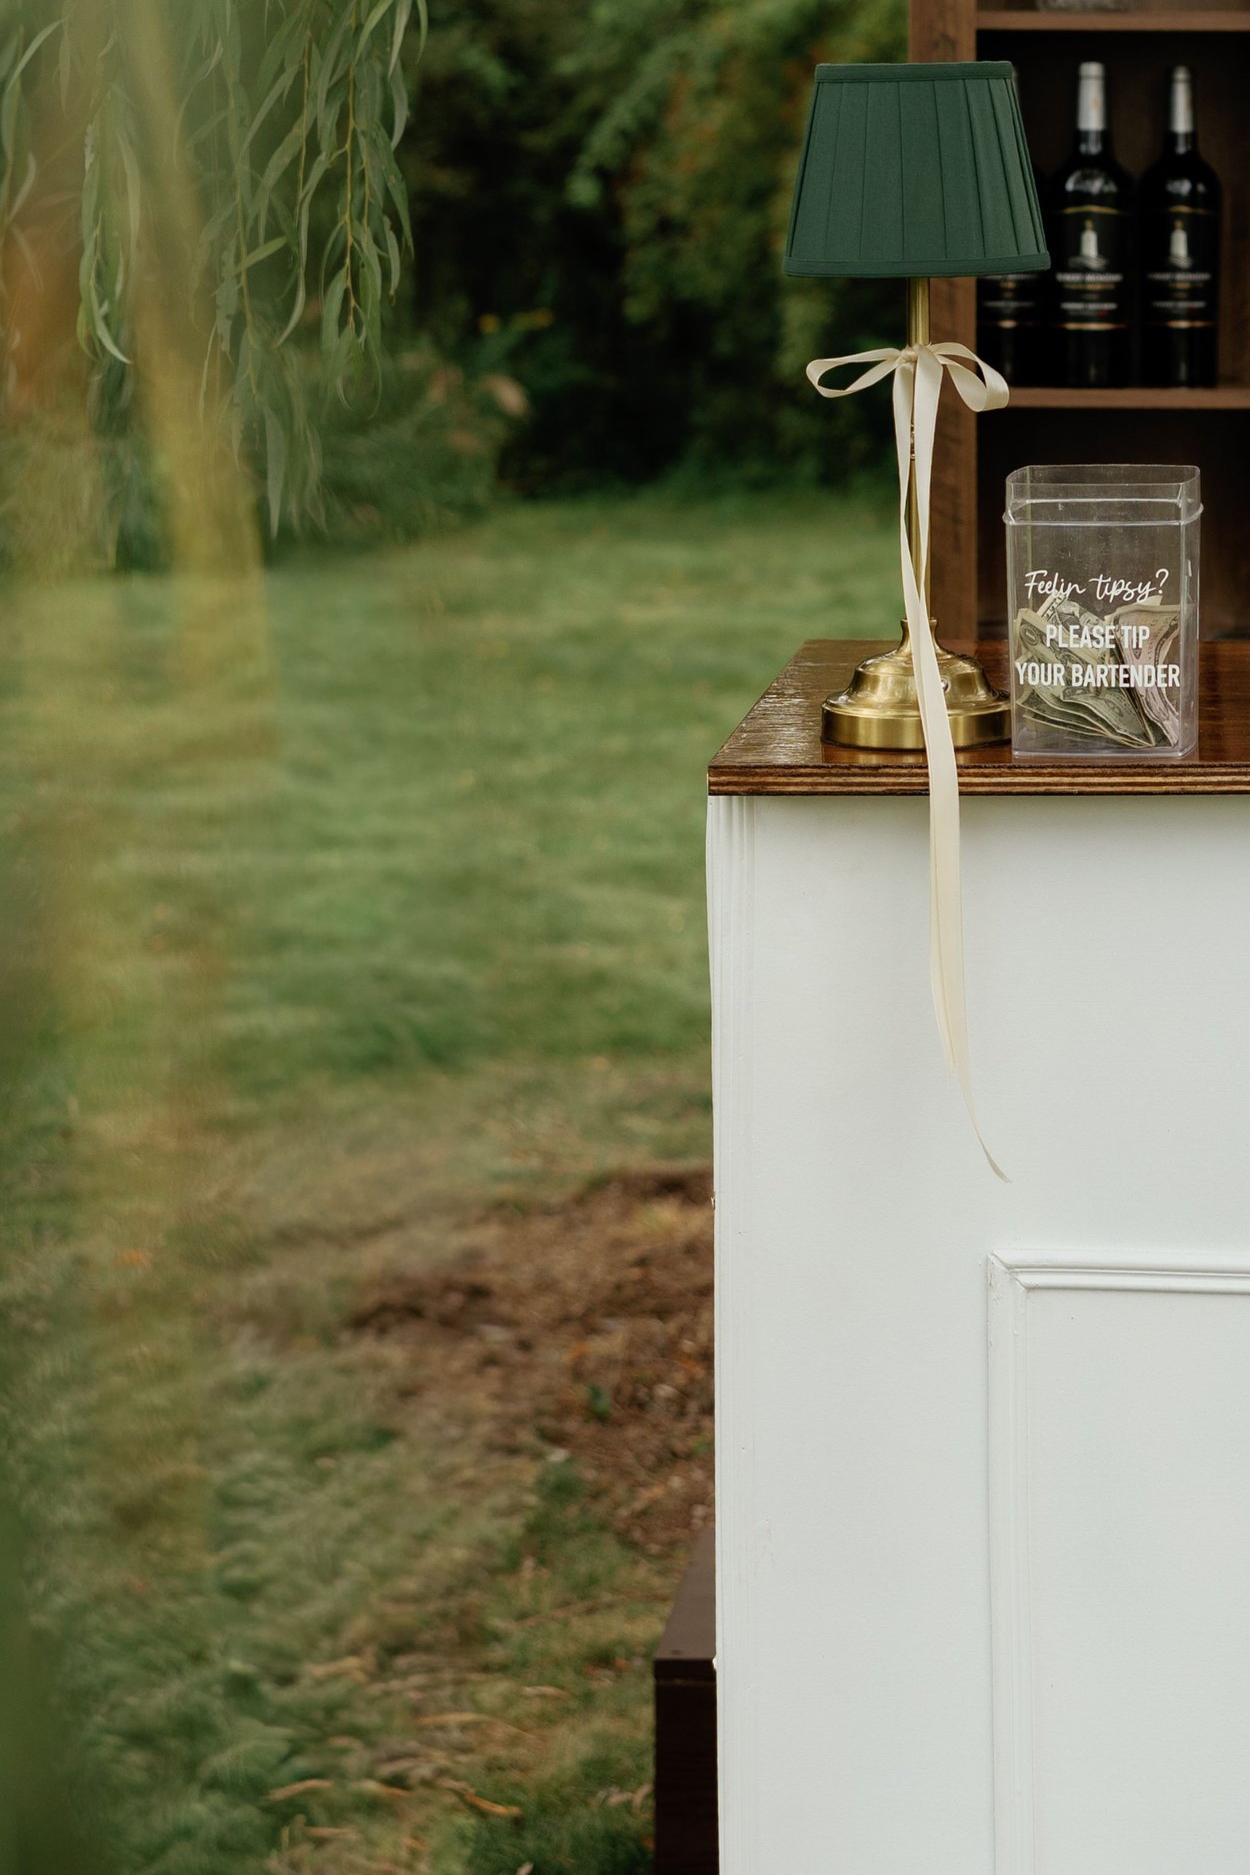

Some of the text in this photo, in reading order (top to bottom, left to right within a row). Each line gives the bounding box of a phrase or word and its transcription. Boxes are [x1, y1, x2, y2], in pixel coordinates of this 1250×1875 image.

[1024, 568, 1169, 603] Feelin tipsy?
[1046, 624, 1150, 649] PLEASE TIP
[1015, 662, 1181, 687] YOUR BARTENDER
